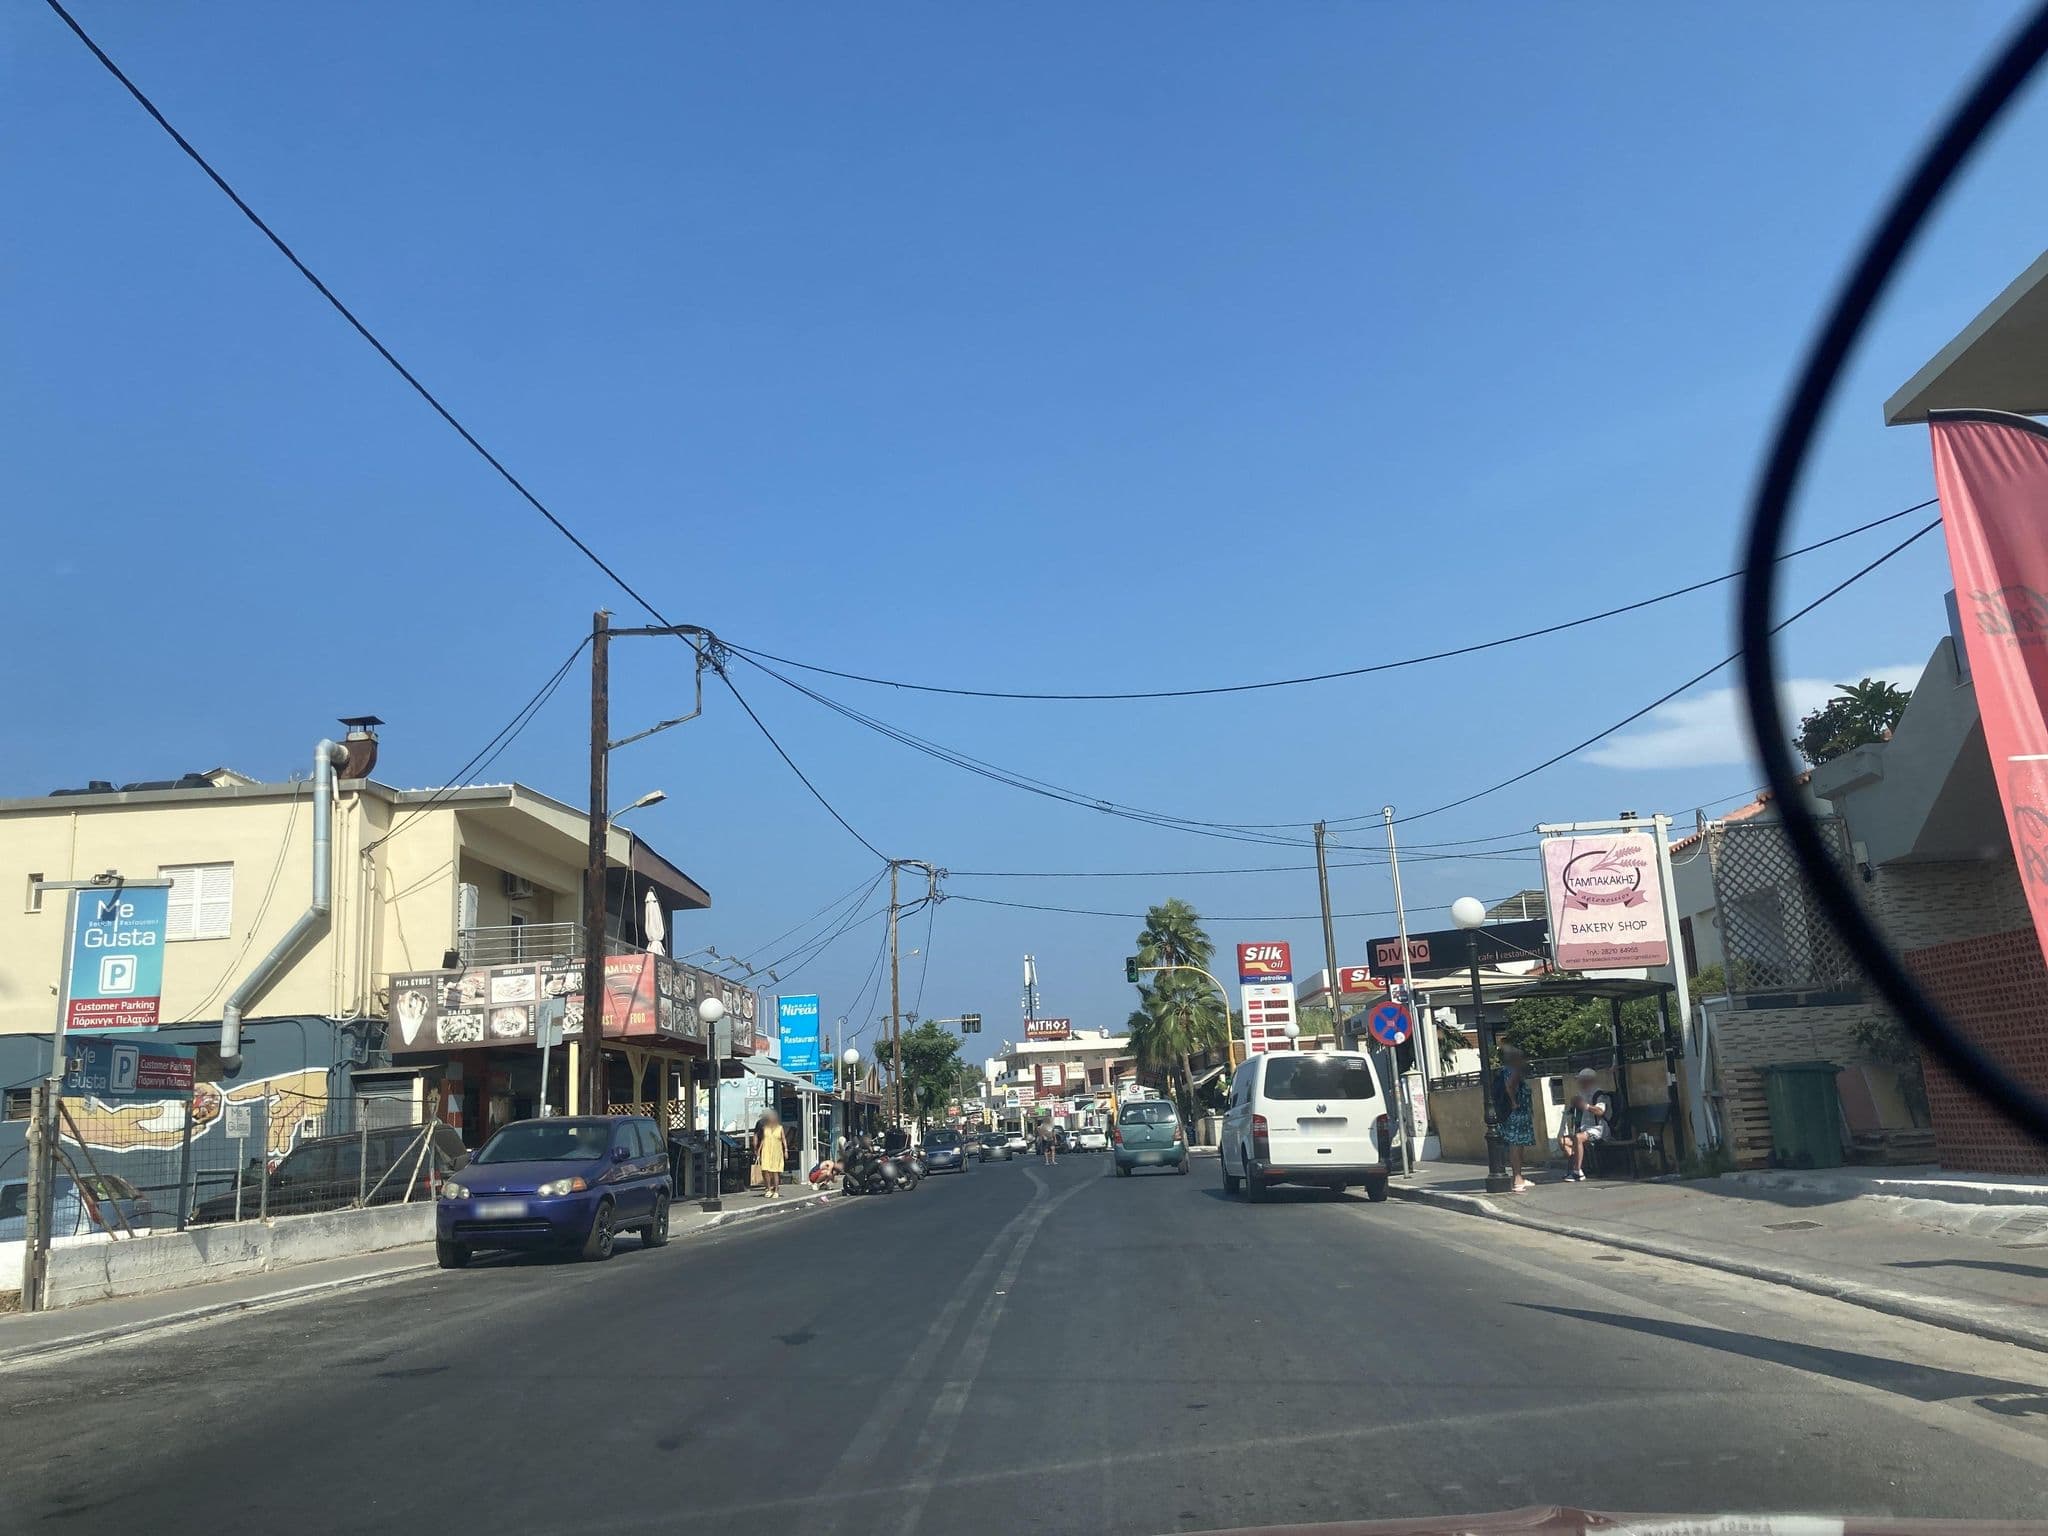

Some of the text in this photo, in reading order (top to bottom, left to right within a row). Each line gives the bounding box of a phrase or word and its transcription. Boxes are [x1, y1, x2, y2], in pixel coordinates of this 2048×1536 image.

[1569, 875, 1635, 887] ΤΑΜΠΑΚΑΚΗΣ
[97, 899, 134, 920] Me
[1571, 920, 1648, 934] BAKERY SHOP
[84, 928, 156, 948] Gusta
[1244, 946, 1283, 960] Silk
[1378, 944, 1428, 962] DIVNO
[1271, 960, 1284, 968] oil
[410, 978, 431, 986] GYROS
[75, 1001, 155, 1012] Customer Parking
[630, 1012, 646, 1025] FOOD
[1027, 1020, 1068, 1031] MITHOS
[780, 1026, 792, 1034] Bar
[75, 1046, 96, 1063] Me
[140, 1059, 192, 1074] Customer Parking
[68, 1072, 106, 1089] Gusta
